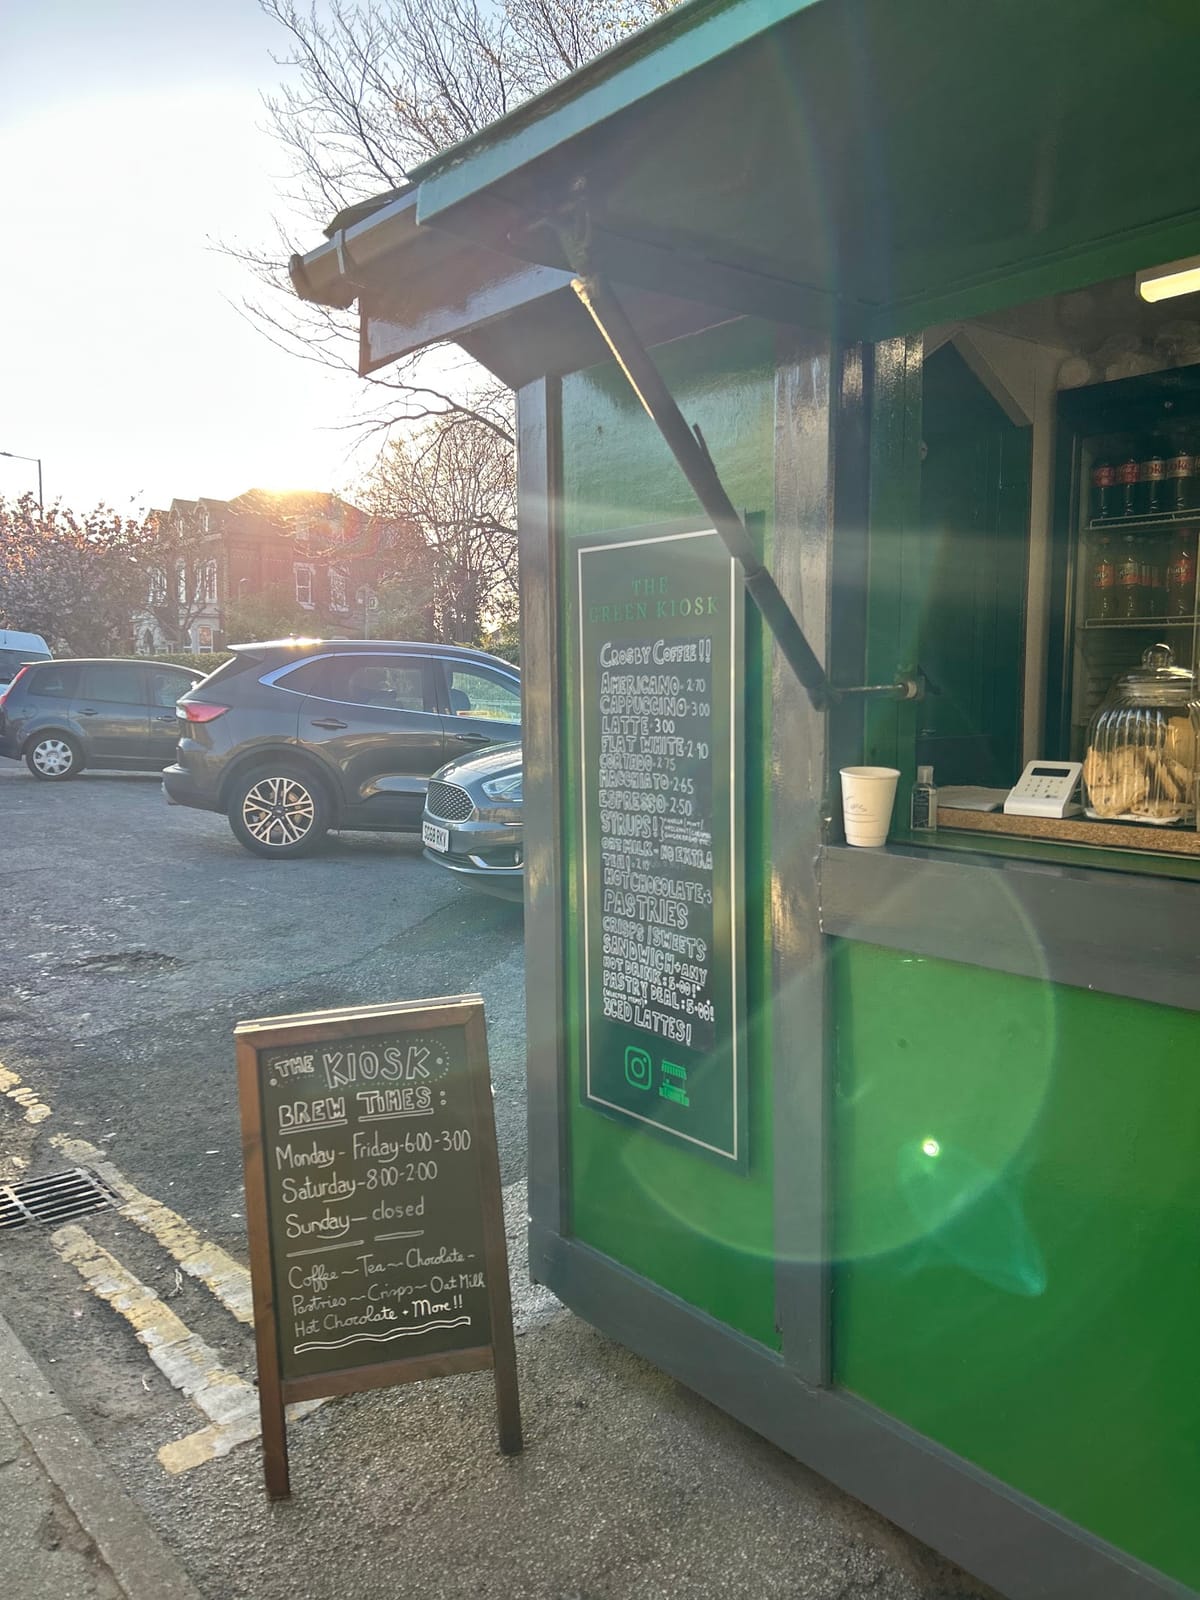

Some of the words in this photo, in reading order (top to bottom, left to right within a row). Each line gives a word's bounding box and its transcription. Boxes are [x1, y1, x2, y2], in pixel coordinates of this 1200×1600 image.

[632, 576, 669, 596] THE
[590, 603, 648, 623] GREEN
[657, 596, 718, 618] KIOSK
[601, 716, 649, 736] LATTE
[600, 735, 637, 753] FLAT
[640, 736, 684, 757] WHITE
[623, 839, 653, 857] MILK
[660, 845, 674, 862] NO
[675, 846, 713, 870] EXTRA
[604, 868, 630, 889] HOT
[603, 889, 688, 929] PASTRIES
[603, 916, 644, 942] CRISPS
[603, 956, 623, 972] HOT
[603, 970, 648, 999] PASTRY
[275, 1055, 315, 1078] THE
[322, 1046, 431, 1089] KIOSK
[278, 1096, 347, 1128] BREW
[275, 1141, 336, 1171] Monday
[285, 1208, 352, 1239] Sunday
[372, 1195, 425, 1221] closed
[288, 1264, 339, 1293] Coffee
[357, 1253, 387, 1278] Tea
[406, 1246, 465, 1269] Chocolate
[292, 1294, 347, 1316] Pastries
[367, 1282, 415, 1303] Crisps
[430, 1275, 457, 1294] Oat
[459, 1272, 487, 1290] Milk
[294, 1321, 321, 1338] Hot
[323, 1304, 399, 1331] Chocolate
